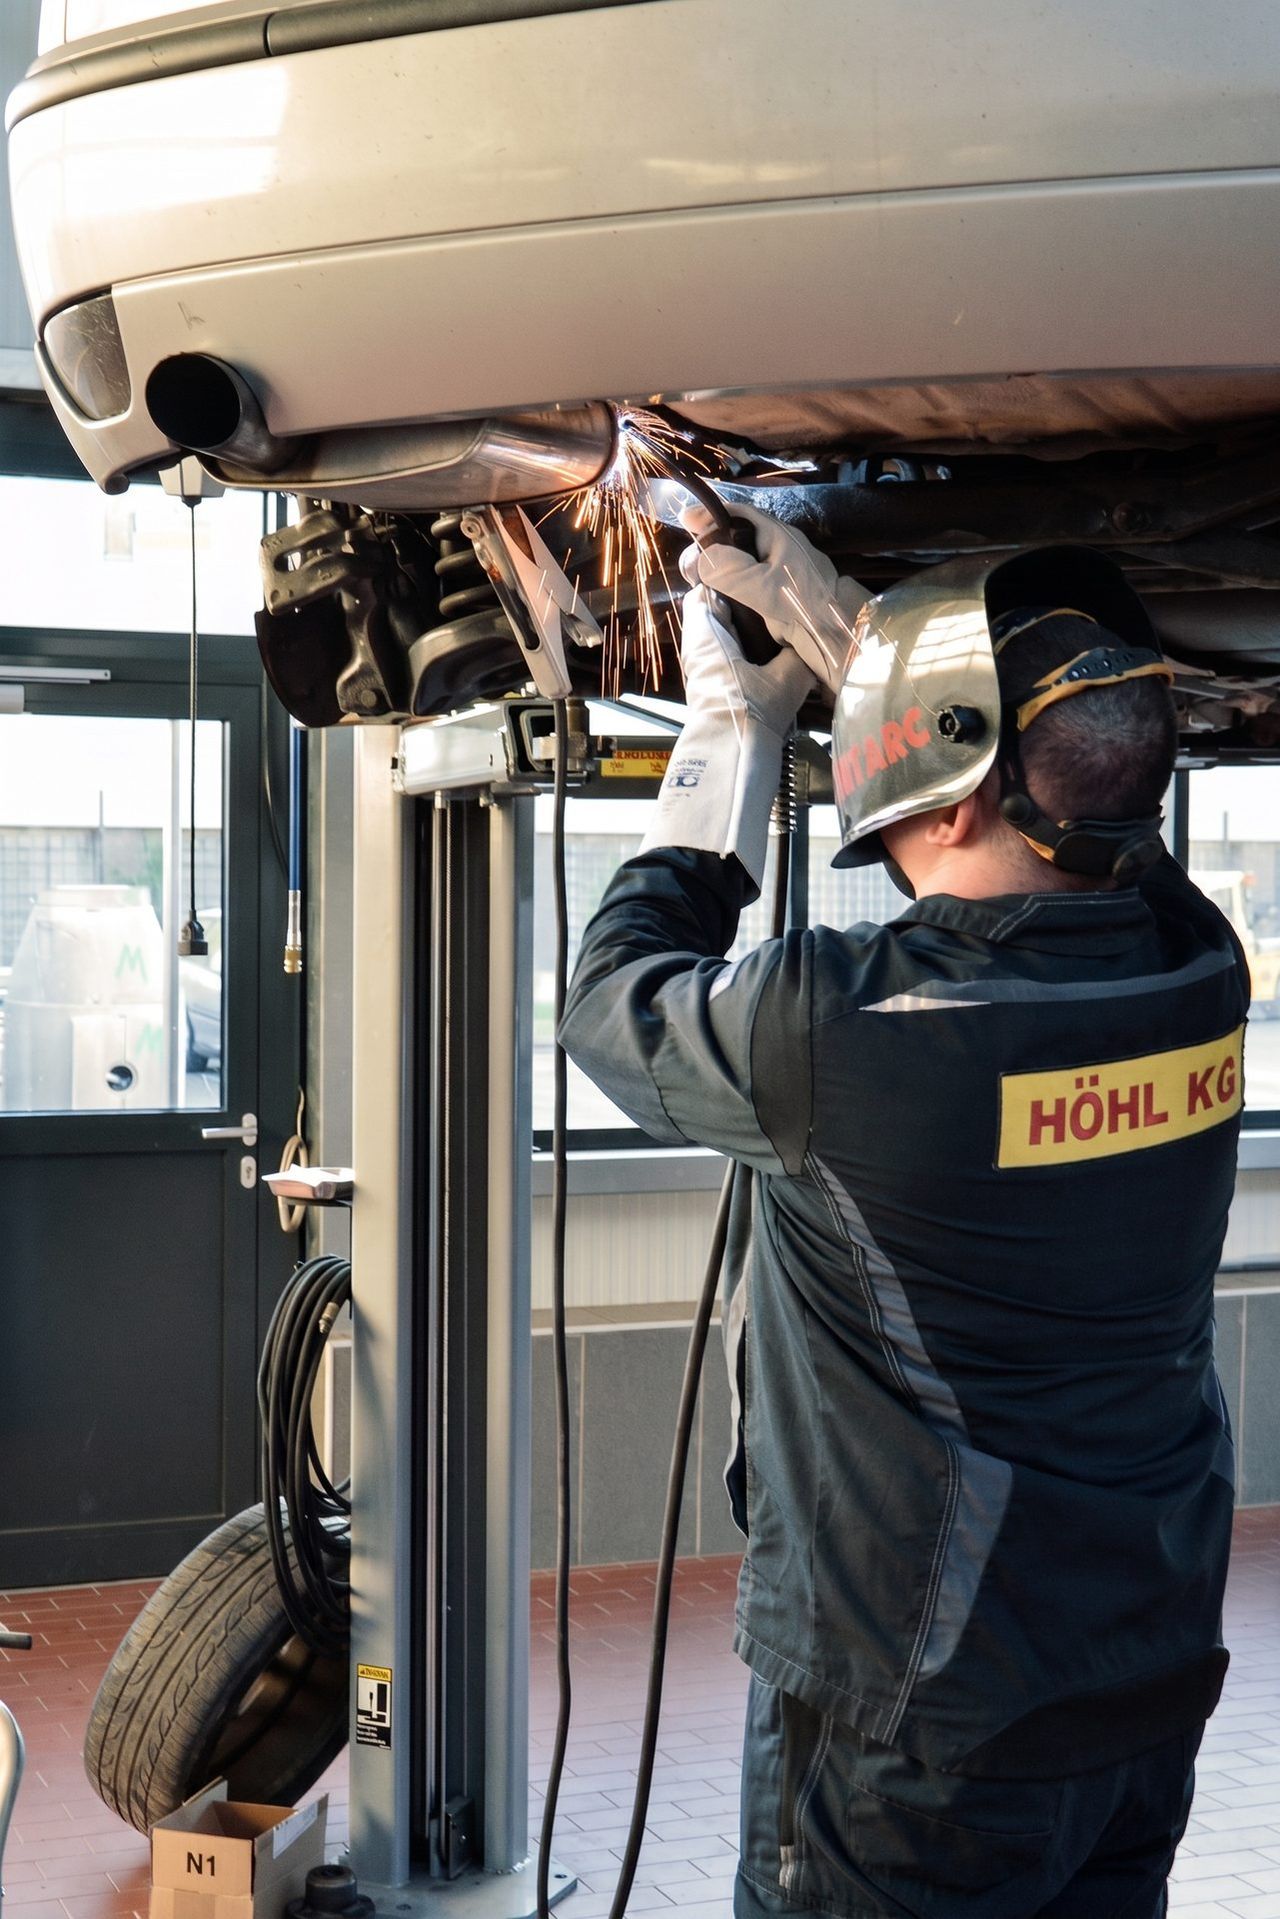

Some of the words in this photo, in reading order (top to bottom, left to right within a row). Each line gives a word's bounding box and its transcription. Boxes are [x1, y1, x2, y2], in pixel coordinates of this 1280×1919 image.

[1029, 1074, 1169, 1146] HÖHL
[1187, 1056, 1236, 1116] KG
[186, 1851, 216, 1876] N1
